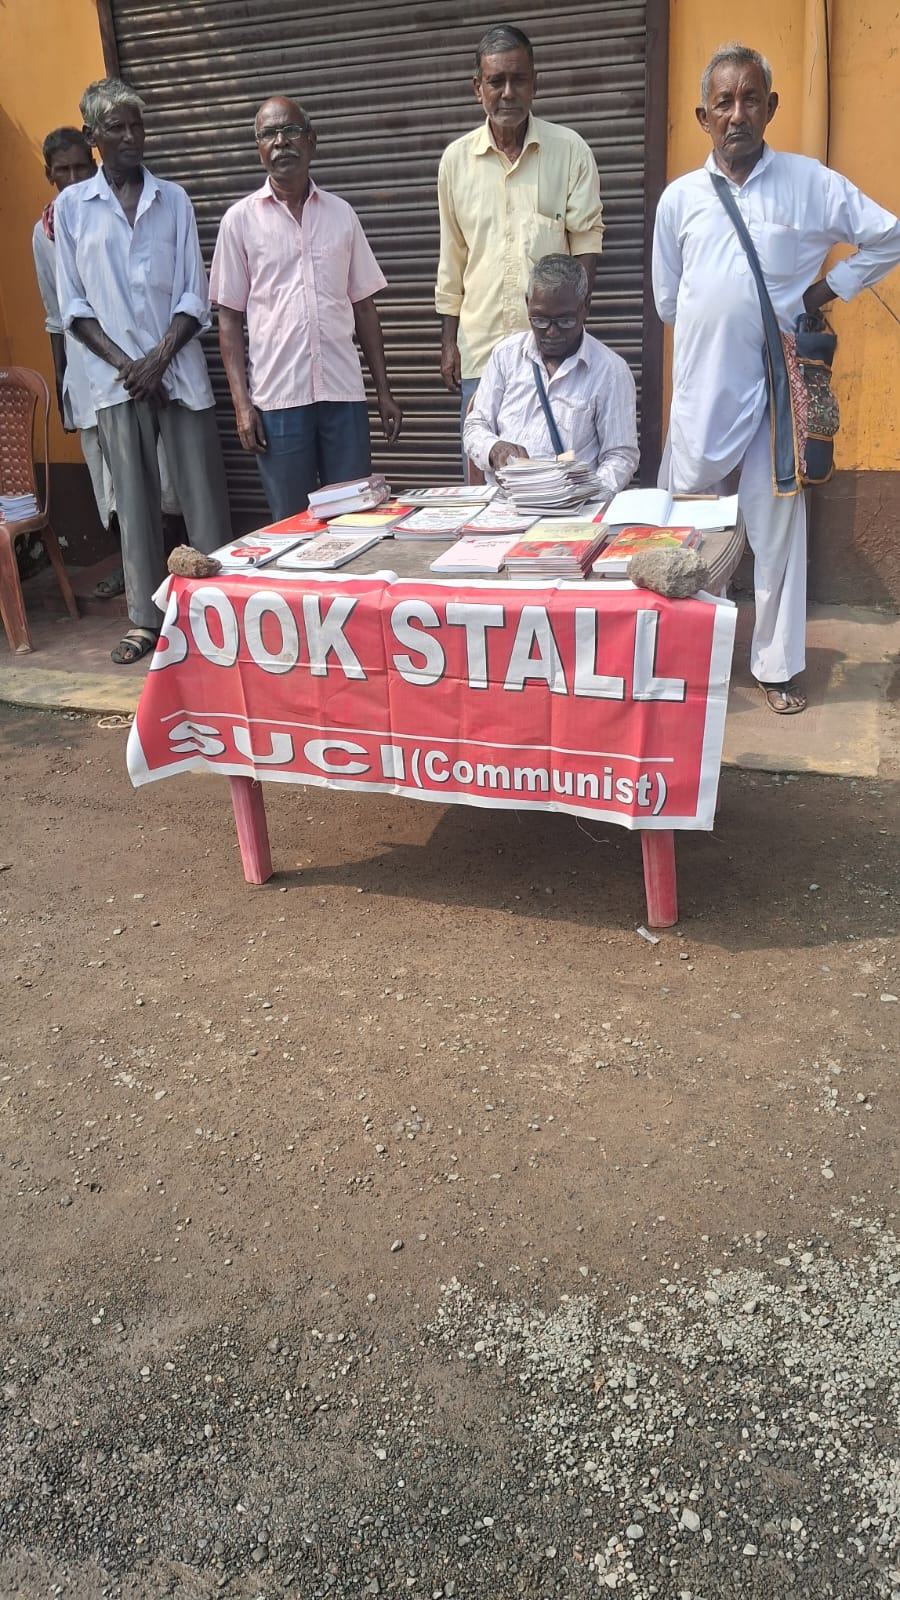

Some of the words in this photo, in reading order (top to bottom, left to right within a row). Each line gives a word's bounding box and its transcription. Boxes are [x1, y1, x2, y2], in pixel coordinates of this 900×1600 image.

[150, 586, 368, 681] BOOK
[390, 599, 686, 702] STALL
[410, 748, 668, 816] (Communist)
